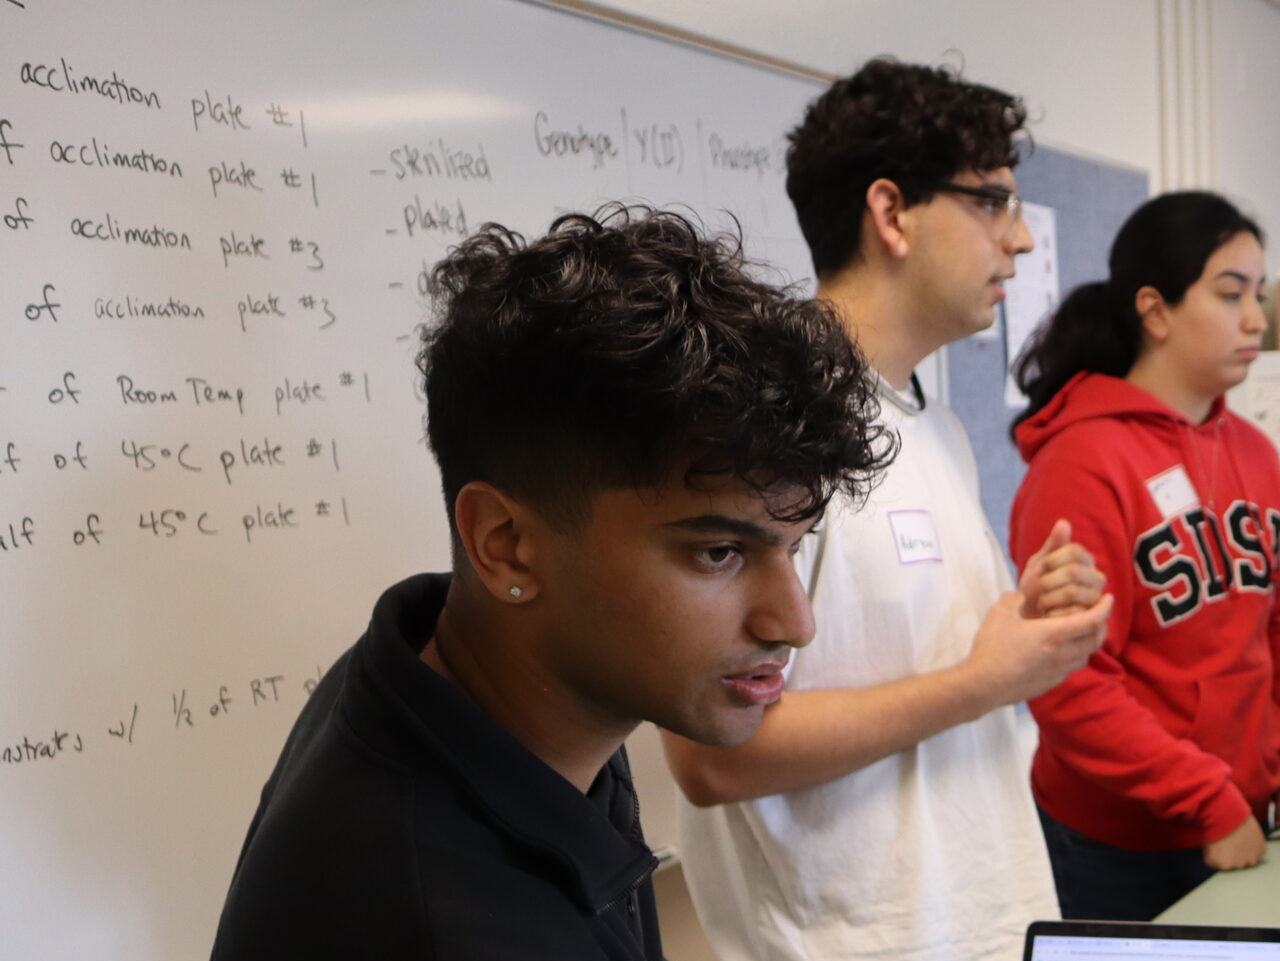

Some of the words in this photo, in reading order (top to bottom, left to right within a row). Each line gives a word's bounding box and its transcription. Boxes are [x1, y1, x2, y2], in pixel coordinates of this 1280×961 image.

[20, 57, 161, 109] acclimation
[191, 90, 251, 131] plate
[50, 138, 182, 177] acclimation
[208, 161, 262, 197] plate
[4, 197, 34, 229] of
[70, 213, 191, 250] acclimation
[219, 234, 271, 268] plate
[288, 237, 324, 271] #3
[25, 284, 60, 322] of
[95, 297, 204, 319] acclimation
[237, 294, 286, 332] plate
[298, 295, 336, 330] #3
[48, 372, 81, 404] of
[117, 375, 177, 404] Room
[186, 378, 244, 415] Temp
[275, 378, 324, 415] plate
[54, 441, 87, 470] of
[219, 438, 286, 484] plate
[73, 513, 103, 546] of
[242, 505, 299, 542] plate
[210, 685, 231, 717] of
[250, 674, 285, 707] RT
